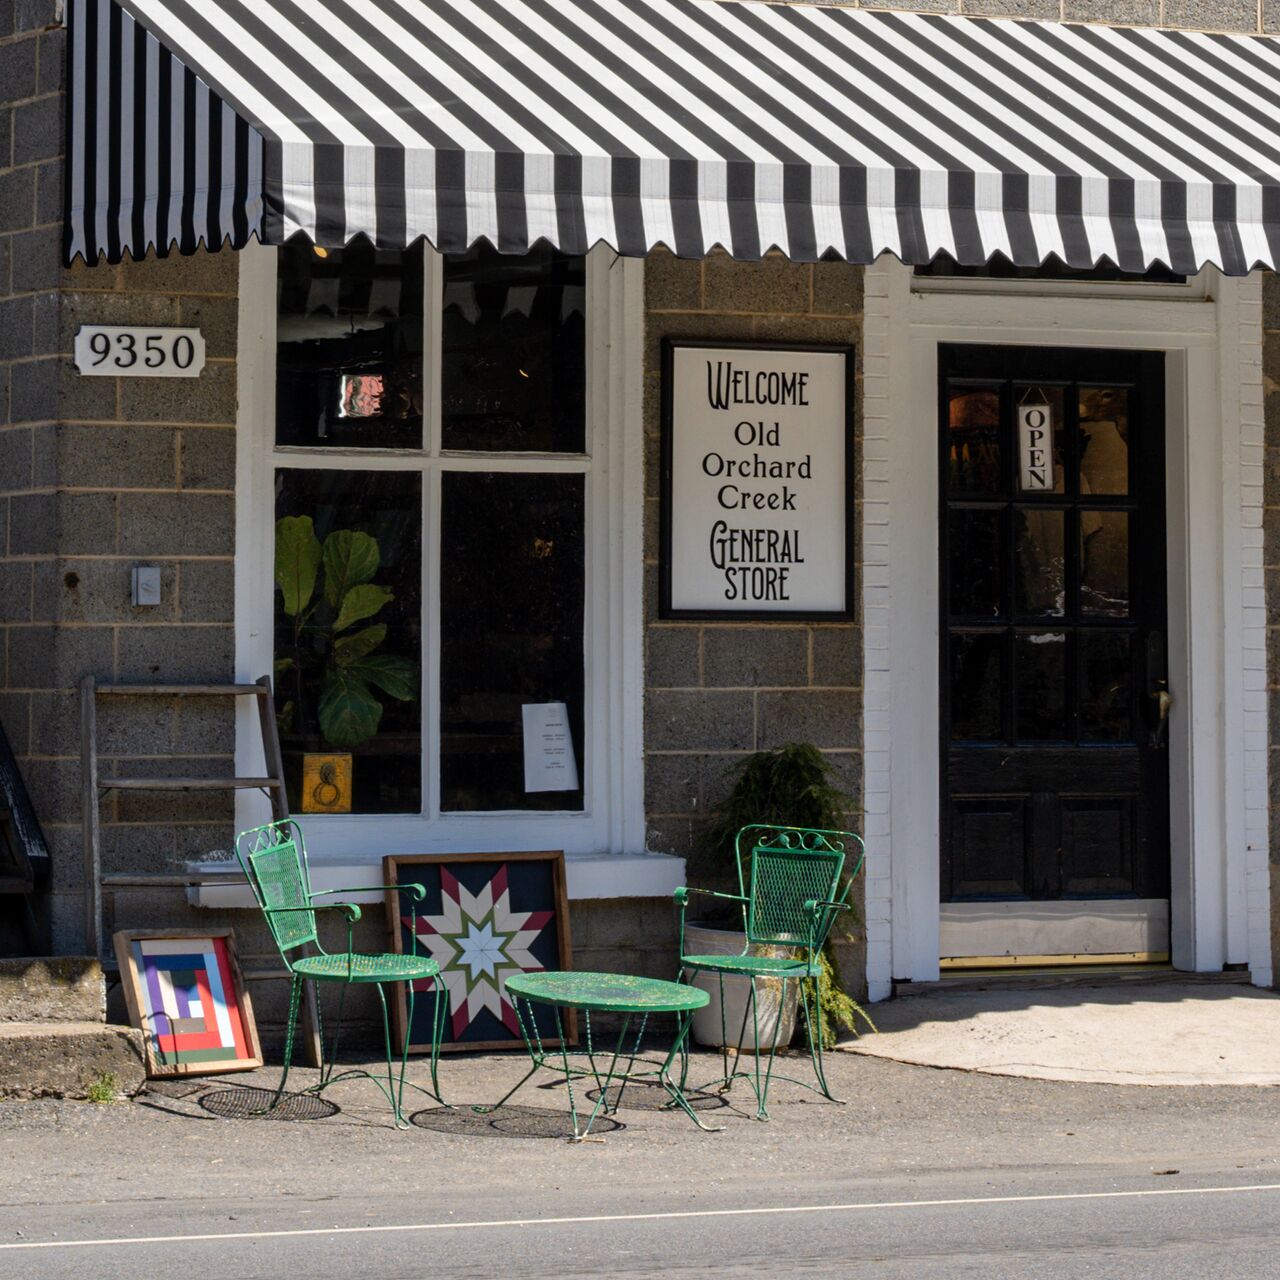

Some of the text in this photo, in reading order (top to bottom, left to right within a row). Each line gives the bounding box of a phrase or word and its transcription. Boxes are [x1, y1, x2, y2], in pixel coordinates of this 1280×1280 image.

[88, 332, 196, 369] 9350
[734, 421, 780, 447] Old
[1024, 408, 1047, 489] OPEN
[702, 452, 812, 479] Orchard
[717, 484, 797, 511] Creek
[724, 566, 790, 600] STORE
